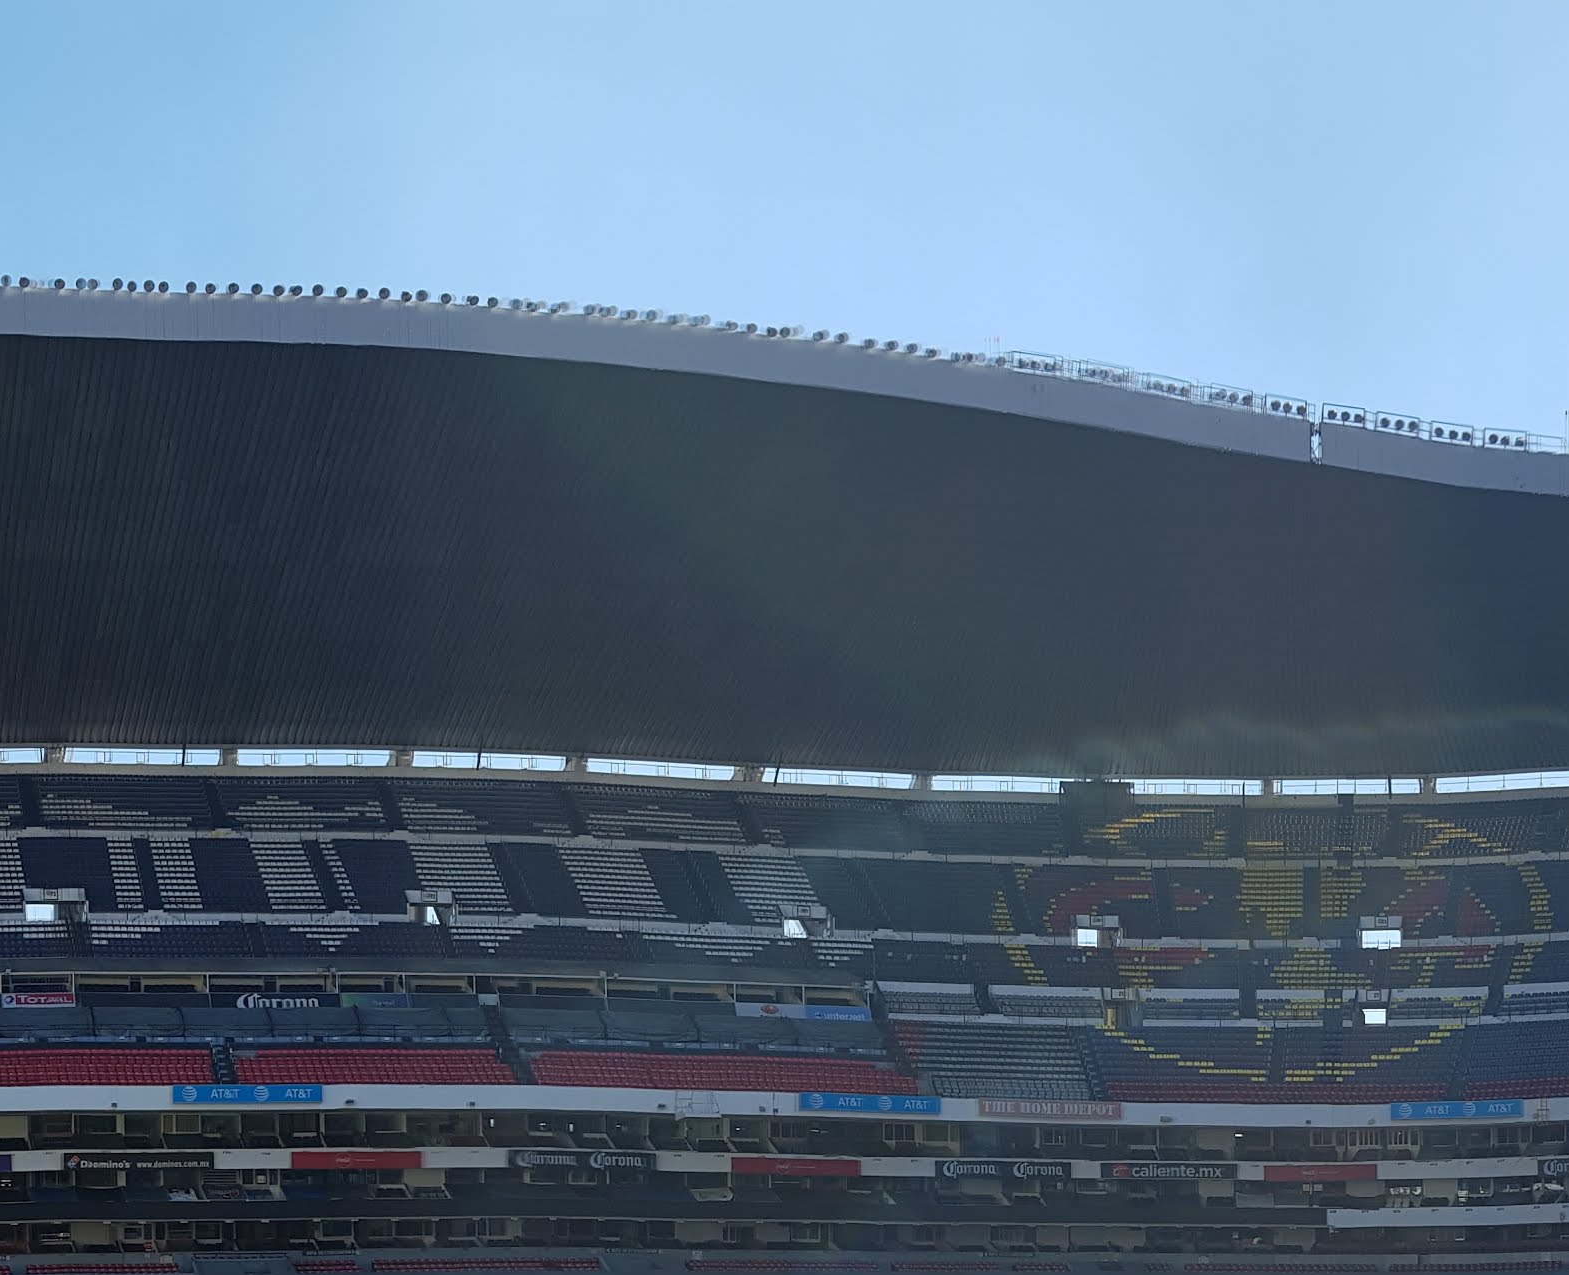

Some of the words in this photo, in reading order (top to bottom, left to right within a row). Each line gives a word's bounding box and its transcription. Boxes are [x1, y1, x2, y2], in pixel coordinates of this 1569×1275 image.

[236, 992, 320, 1008] Corona
[211, 1088, 240, 1099] AT&T
[285, 1088, 313, 1099] AT&T
[837, 1097, 863, 1107] AT&T
[903, 1099, 928, 1110] AT&T
[1424, 1105, 1451, 1116] AT&T
[1487, 1103, 1513, 1113] AT&T
[589, 1151, 643, 1168] Corona
[943, 1160, 996, 1177] Corona
[1013, 1160, 1063, 1178] Corona
[1132, 1164, 1222, 1177] caliente.mx
